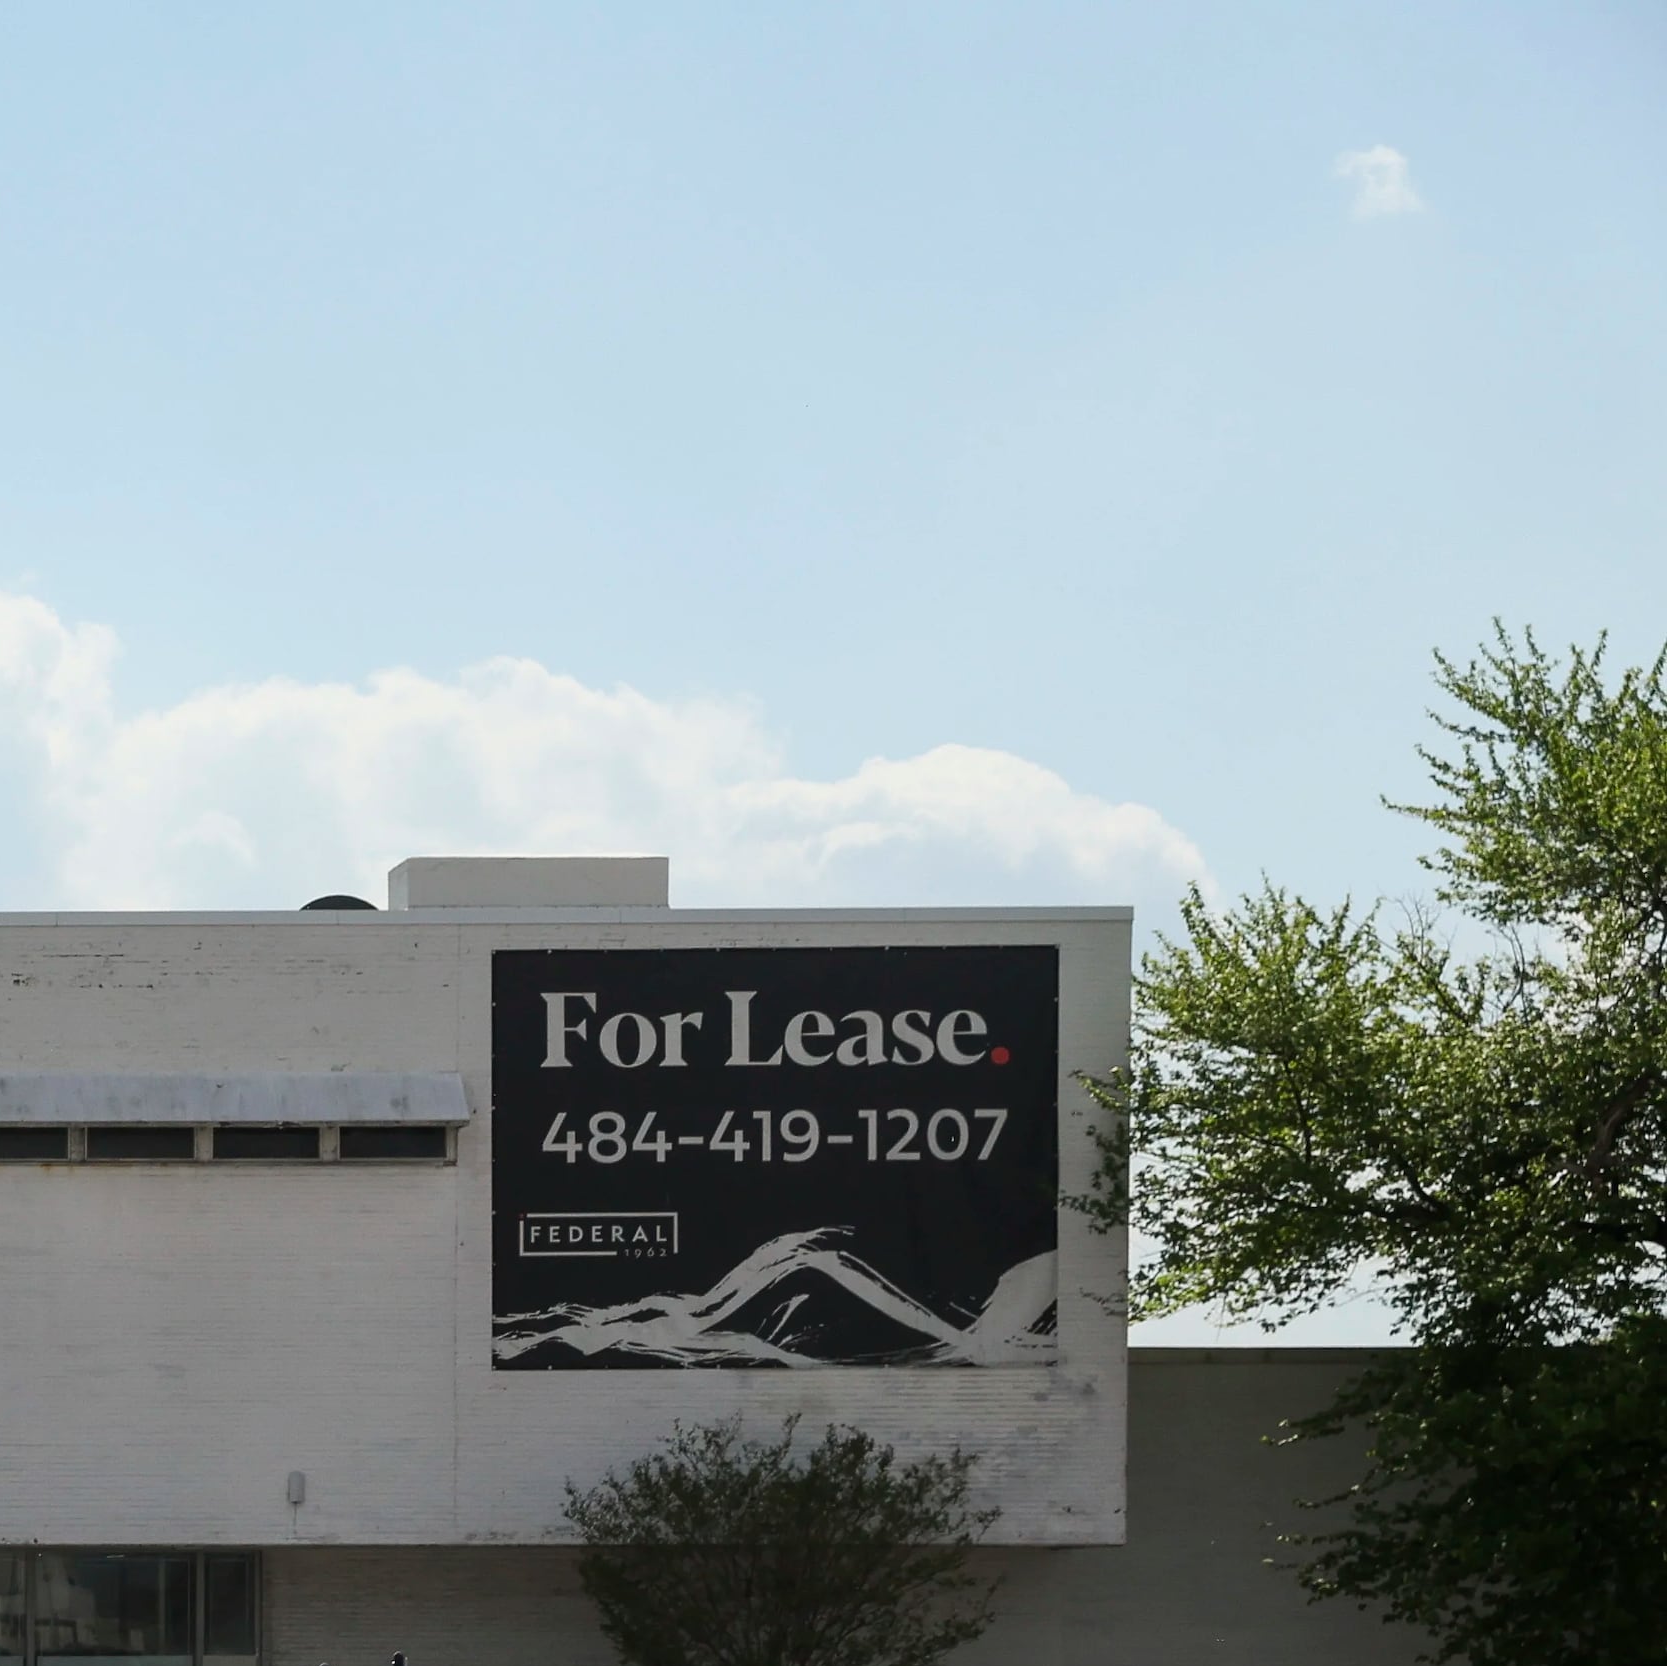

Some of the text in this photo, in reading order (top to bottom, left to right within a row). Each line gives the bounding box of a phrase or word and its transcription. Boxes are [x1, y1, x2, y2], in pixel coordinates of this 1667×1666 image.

[540, 990, 1009, 1069] For Lease.
[541, 1108, 1009, 1164] 484-419-1207
[530, 1225, 667, 1243] FEDERAL
[624, 1247, 668, 1259] 1962
